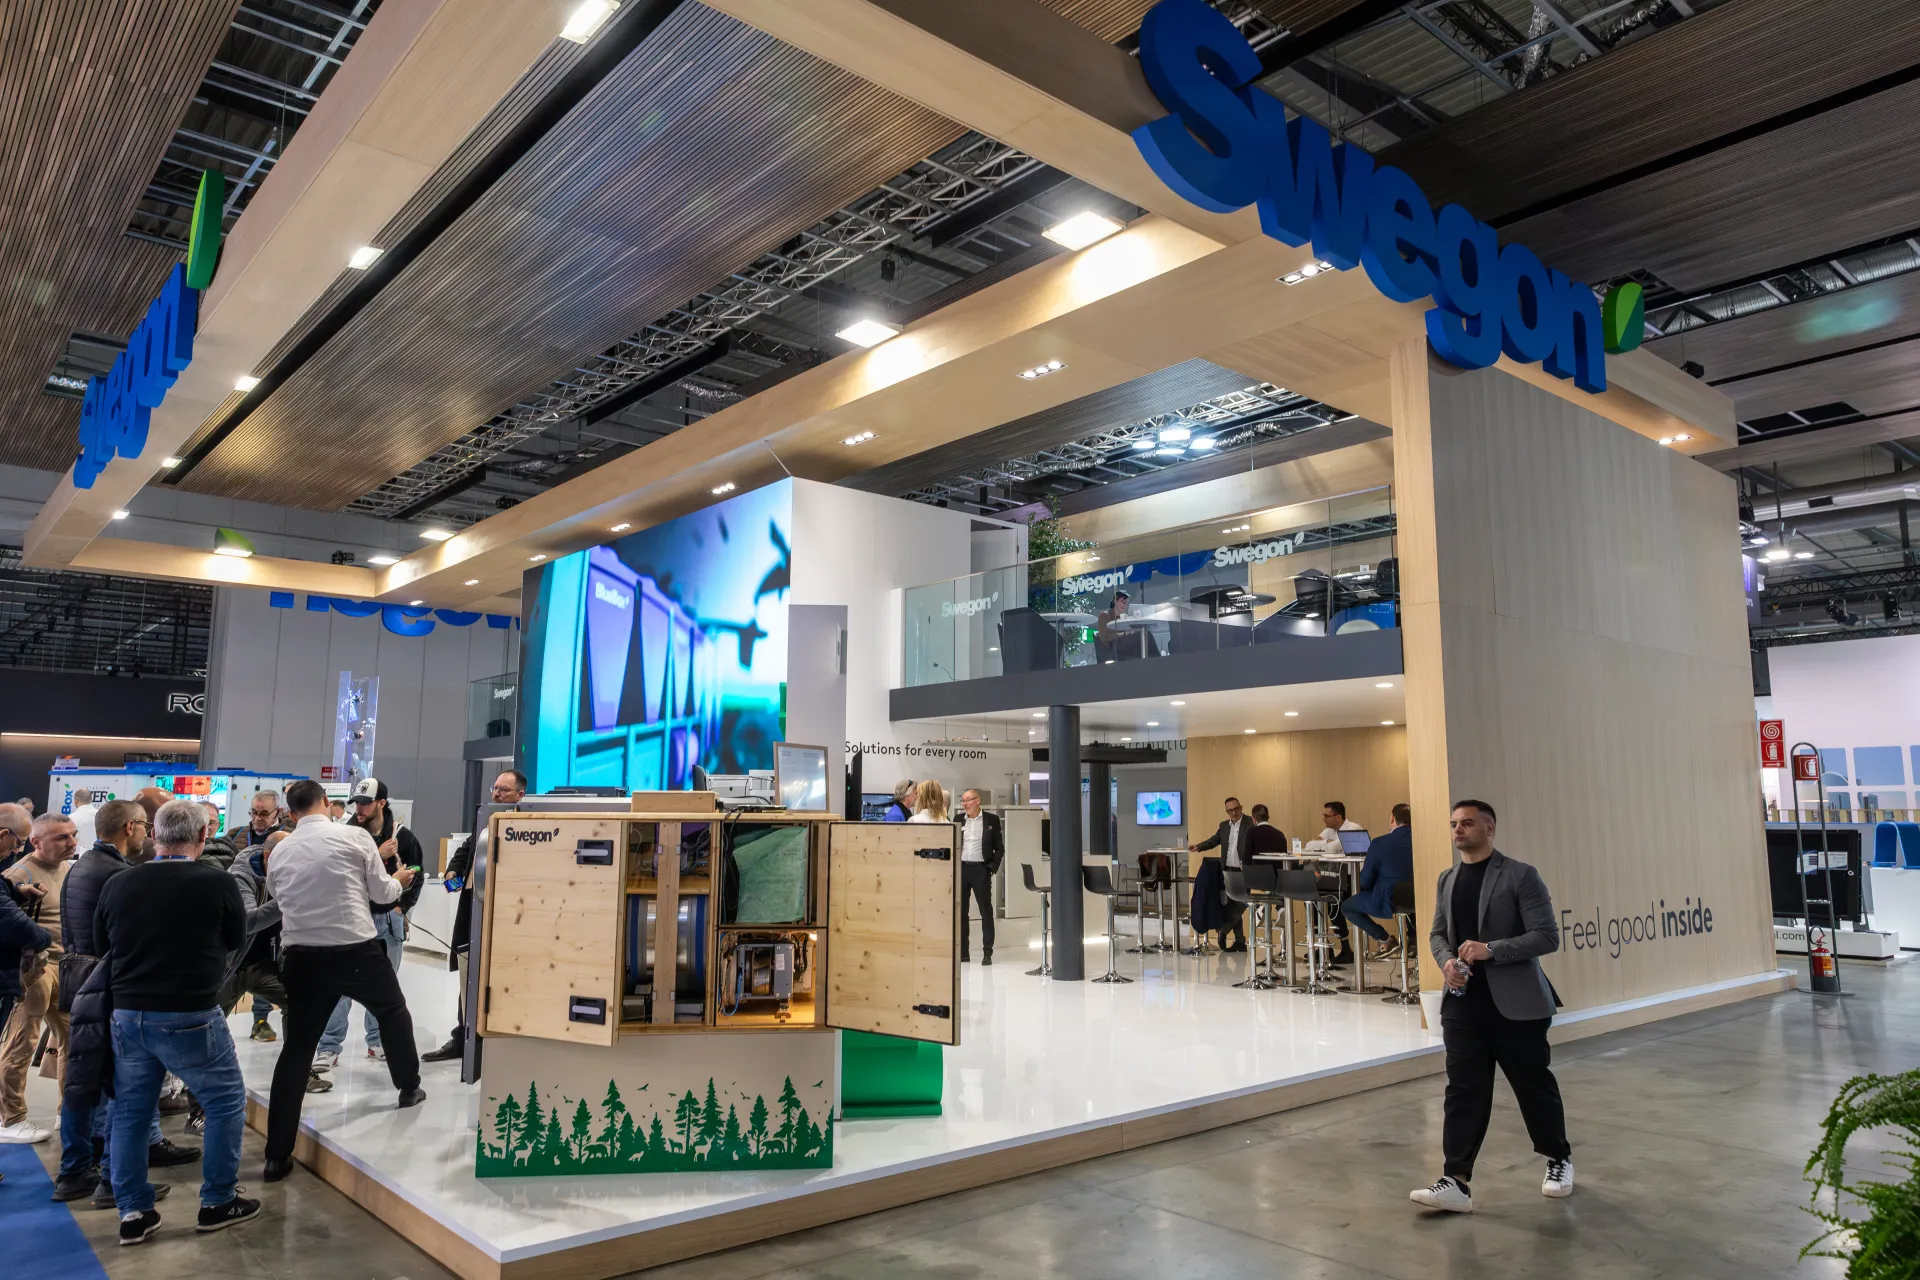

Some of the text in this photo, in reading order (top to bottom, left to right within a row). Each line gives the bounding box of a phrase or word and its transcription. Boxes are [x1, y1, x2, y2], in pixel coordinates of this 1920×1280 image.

[1131, 0, 1607, 394] Swegon
[1214, 539, 1293, 567] Swegon
[1062, 570, 1125, 596] Swegon
[941, 596, 992, 617] Swegon
[494, 688, 512, 700] Swegon
[845, 741, 987, 761] Solutions for every room
[504, 826, 553, 846] Swegon
[1561, 896, 1713, 959] Feel good inside
